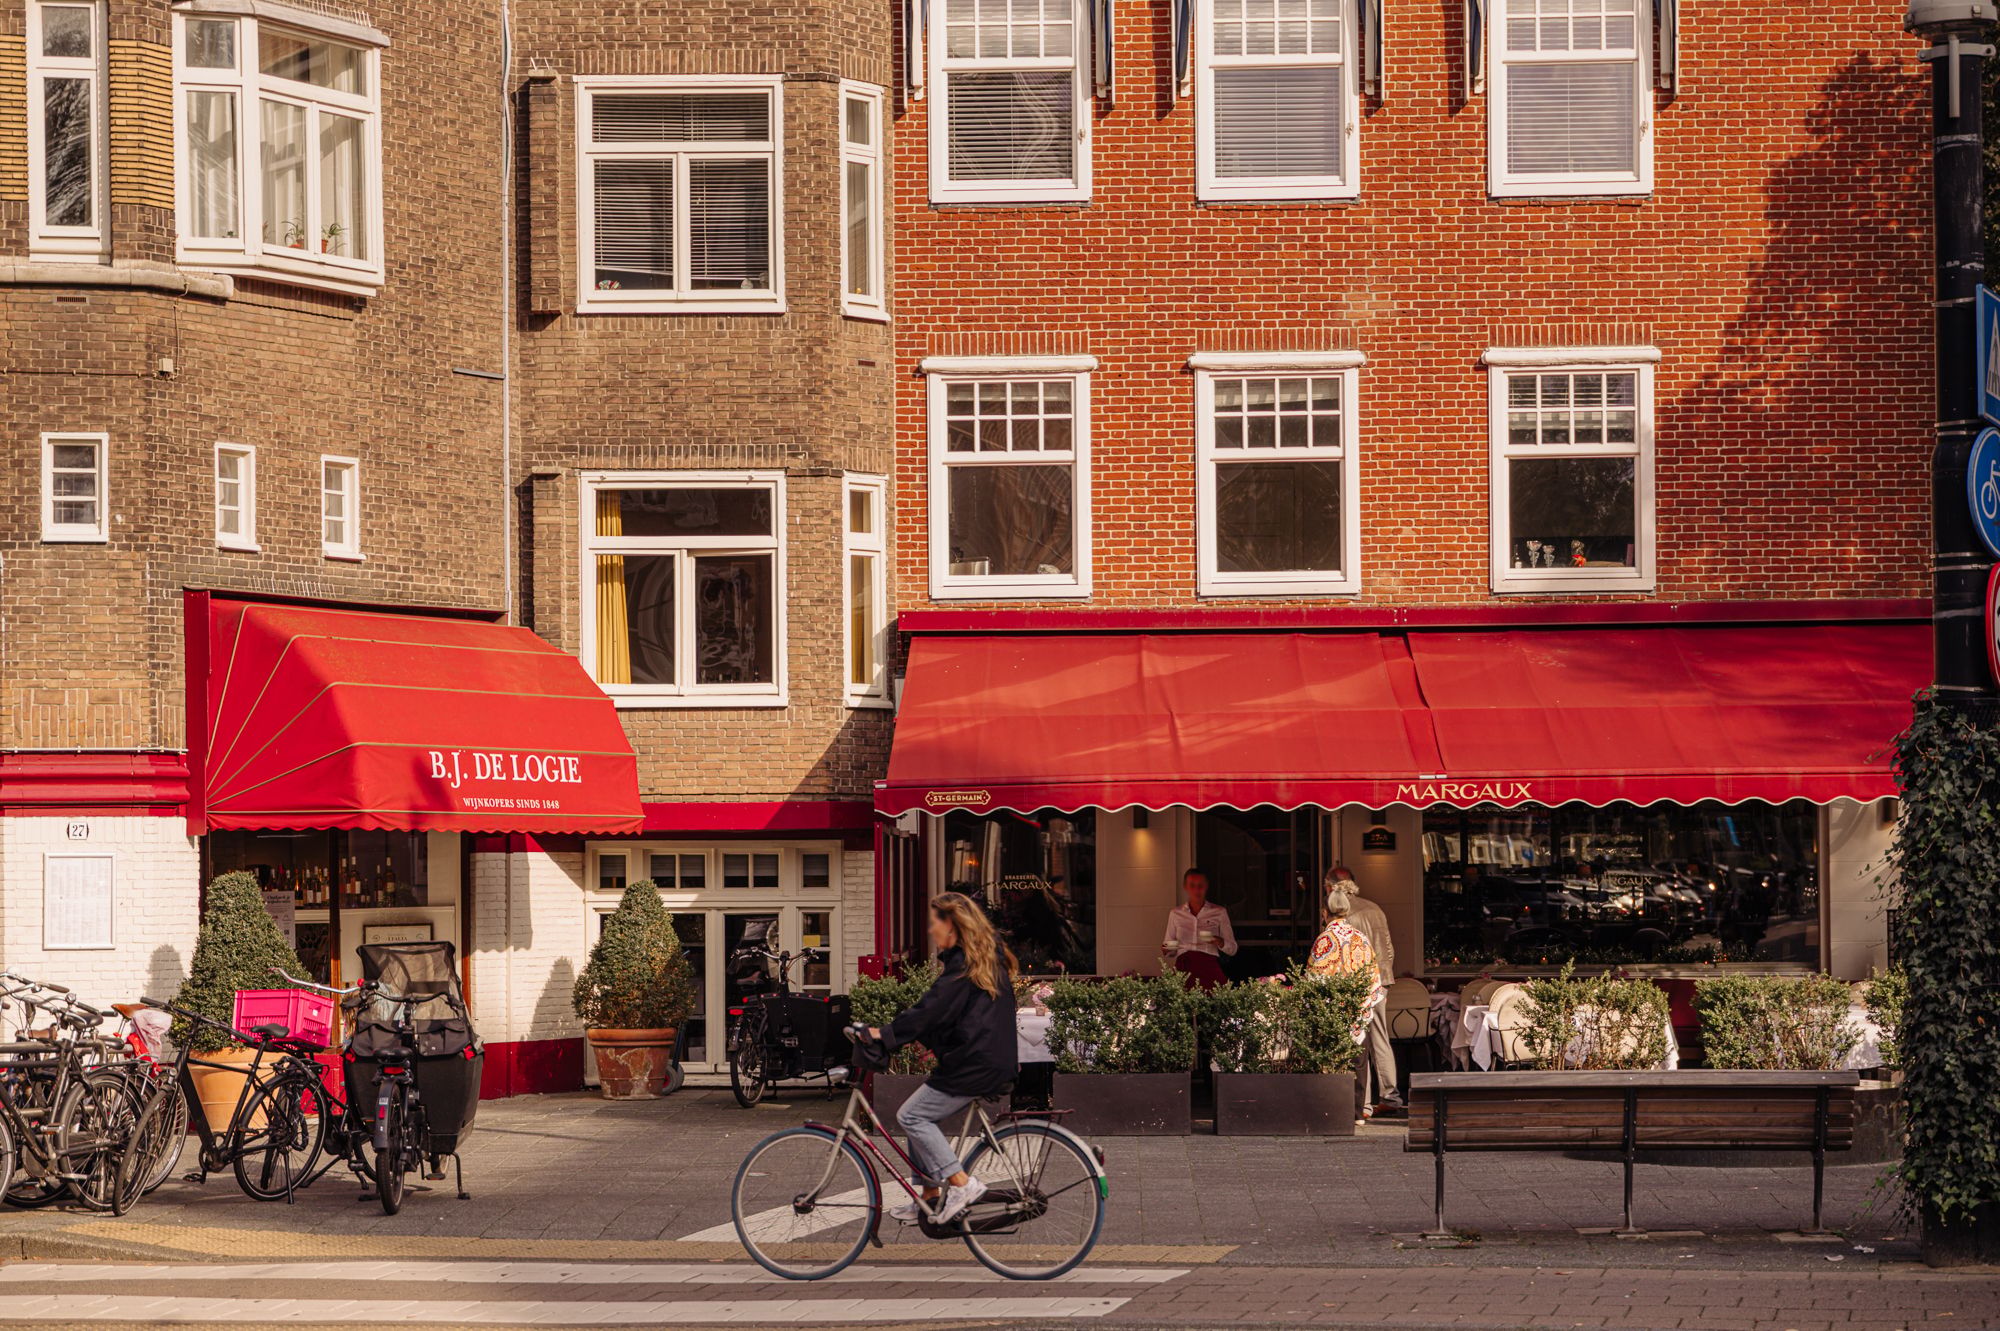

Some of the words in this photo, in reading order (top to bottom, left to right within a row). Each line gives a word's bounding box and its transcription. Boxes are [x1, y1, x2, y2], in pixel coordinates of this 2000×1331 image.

[473, 753, 506, 780] DE
[510, 755, 582, 783] LOGIE
[1396, 783, 1532, 799] MARGAUX
[463, 797, 515, 810] WIJNKOPERS
[517, 799, 540, 809] SINDS
[542, 800, 560, 809] 1848
[72, 825, 85, 836] 27
